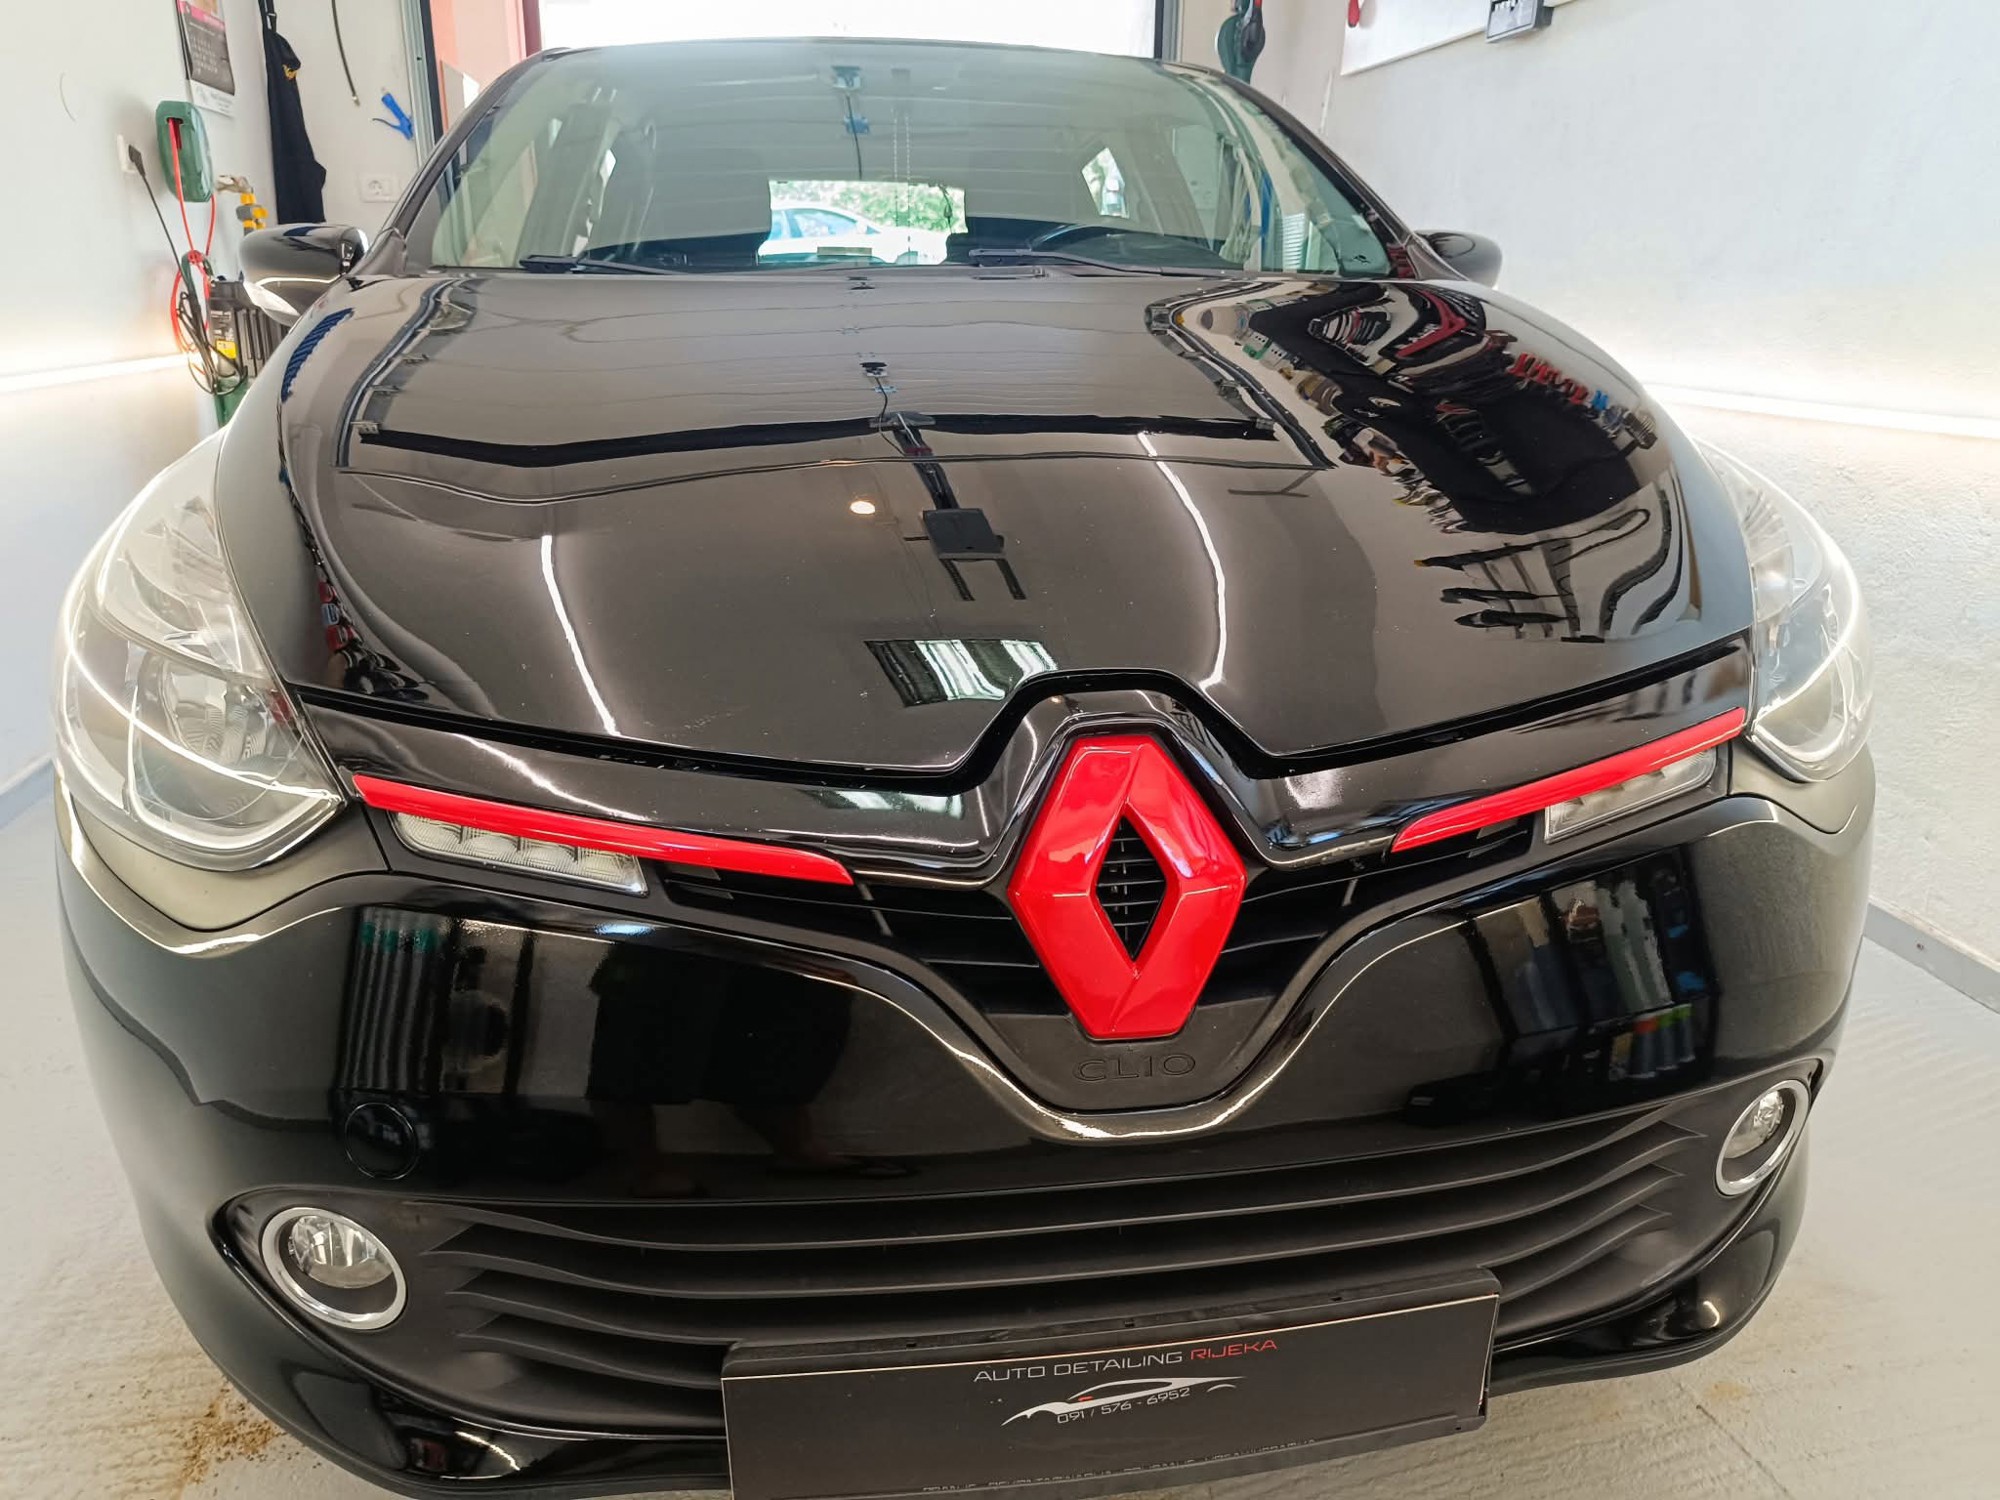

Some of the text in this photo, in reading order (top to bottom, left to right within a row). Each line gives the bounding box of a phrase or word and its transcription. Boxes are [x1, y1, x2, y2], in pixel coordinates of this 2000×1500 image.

[1072, 1053, 1196, 1082] CLIO
[973, 1339, 1277, 1383] AUTO DETAILING RIJEKA
[1056, 1410, 1085, 1424] 091
[1101, 1401, 1132, 1415] 576
[1146, 1387, 1191, 1406] 6952
